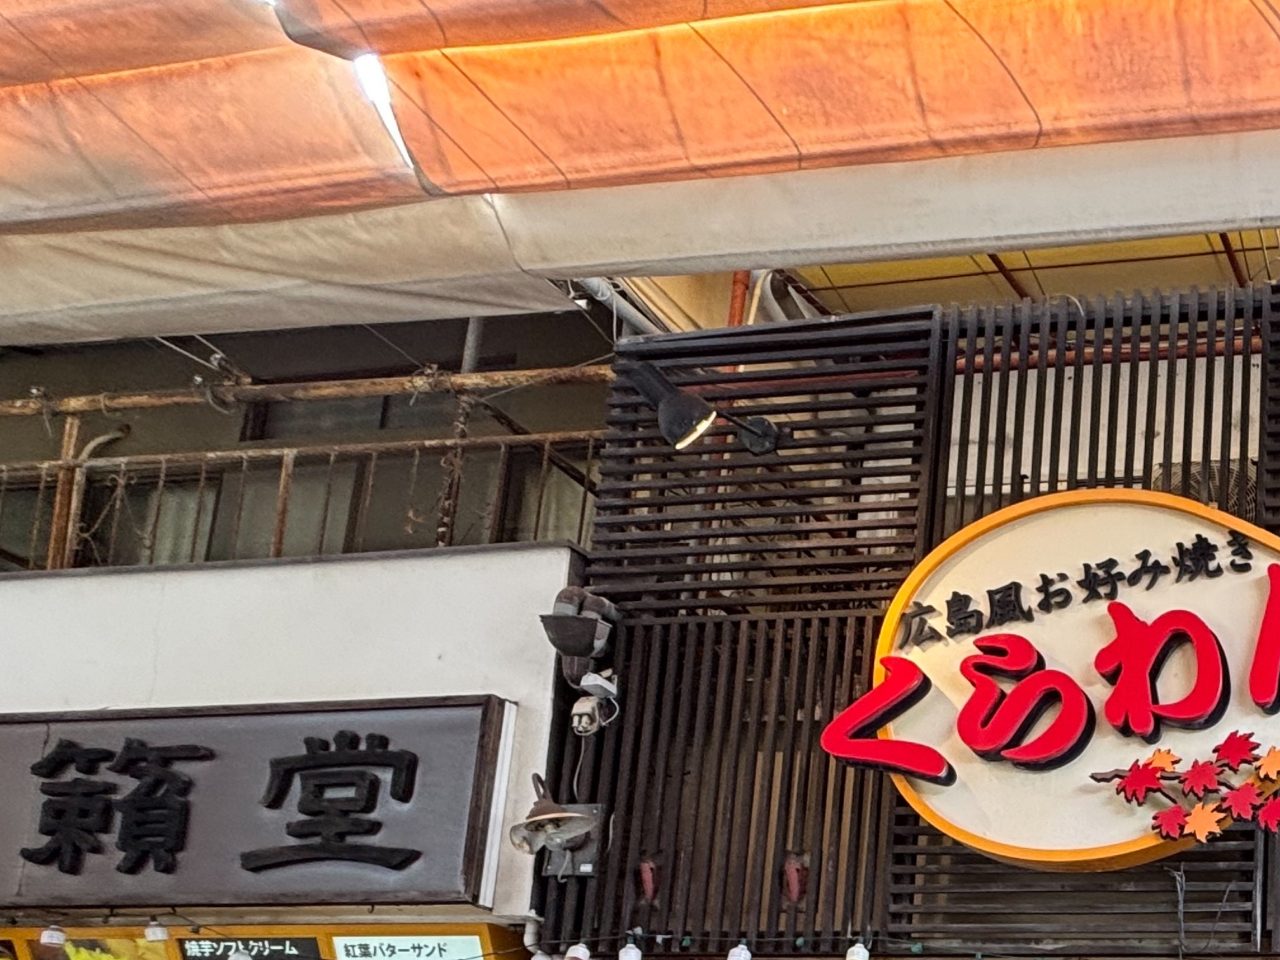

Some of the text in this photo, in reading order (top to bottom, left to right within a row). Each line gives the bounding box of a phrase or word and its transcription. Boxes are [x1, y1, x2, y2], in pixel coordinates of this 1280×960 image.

[898, 530, 1254, 649] 広島風お好み焼き
[344, 942, 447, 958] 紅葉バターサンド
